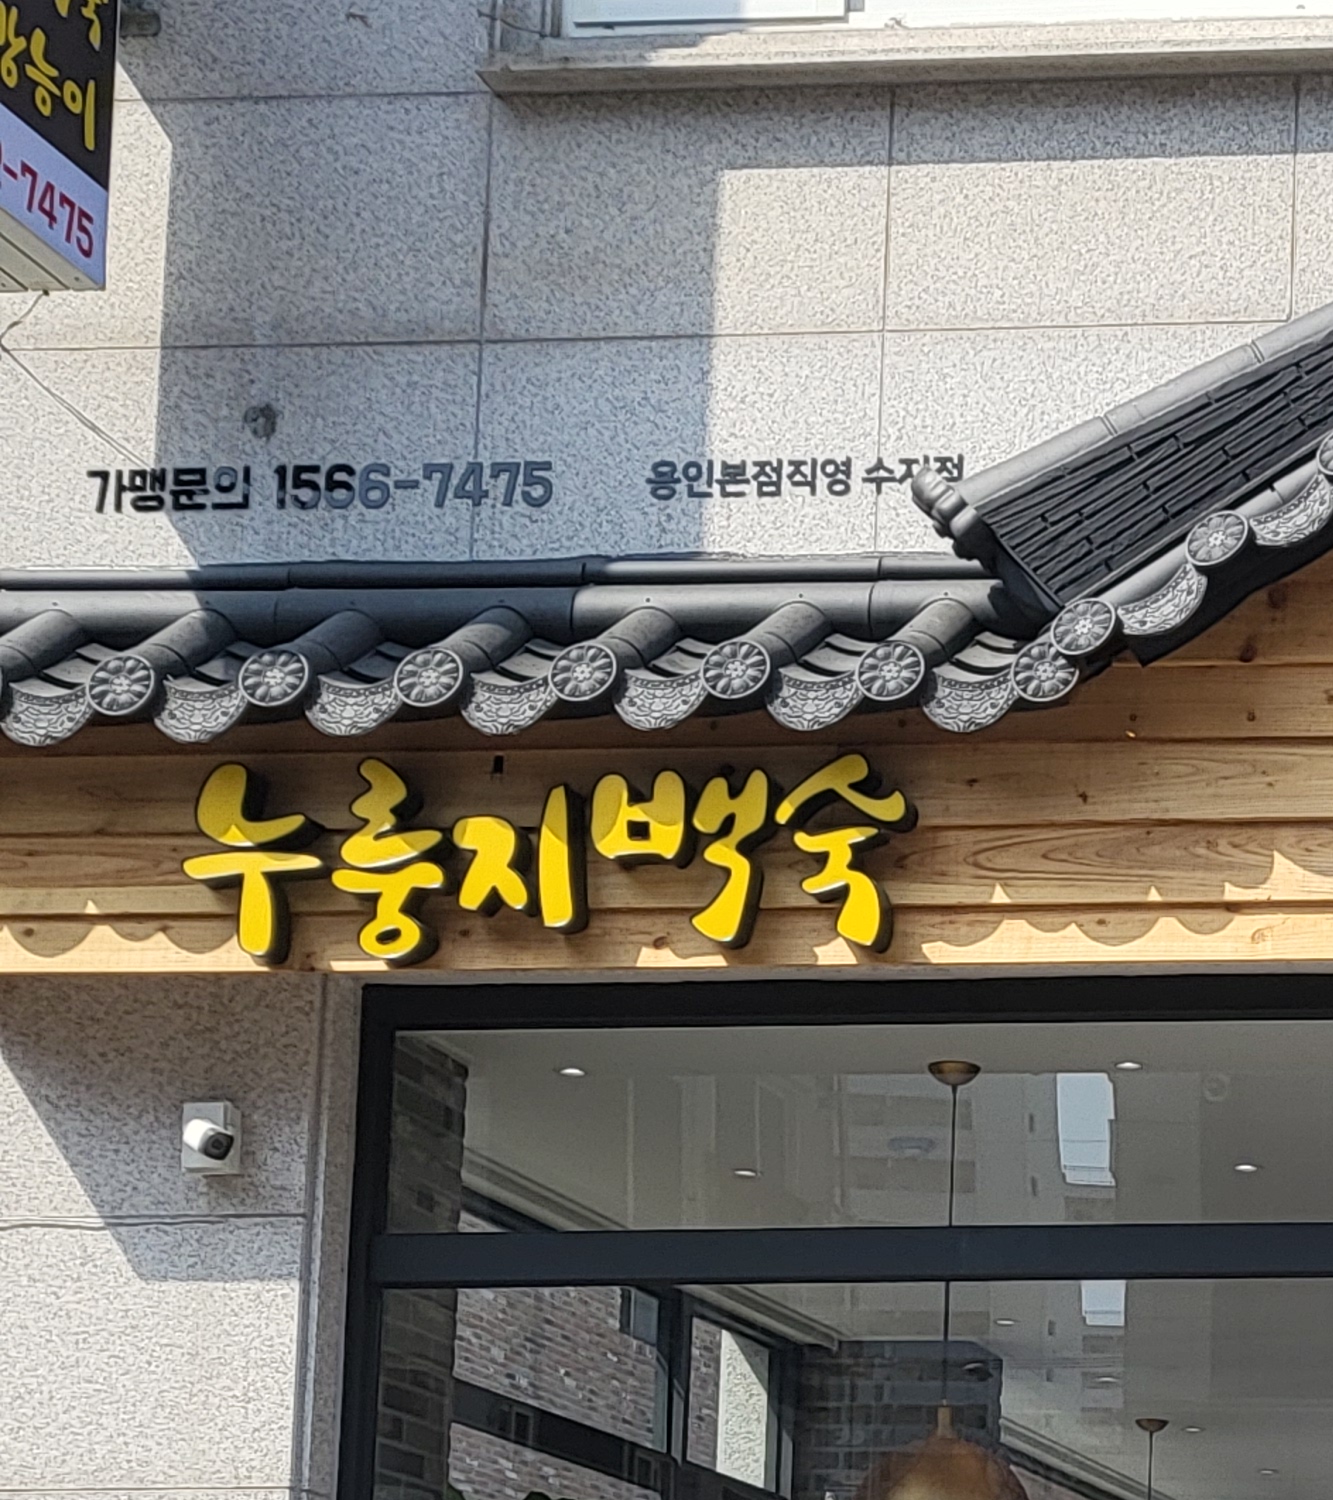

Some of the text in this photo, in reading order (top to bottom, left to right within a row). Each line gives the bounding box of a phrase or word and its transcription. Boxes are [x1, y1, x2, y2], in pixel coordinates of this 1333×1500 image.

[86, 460, 554, 514] 가맹문의 1566-7475
[646, 457, 852, 501] 용인본점직영
